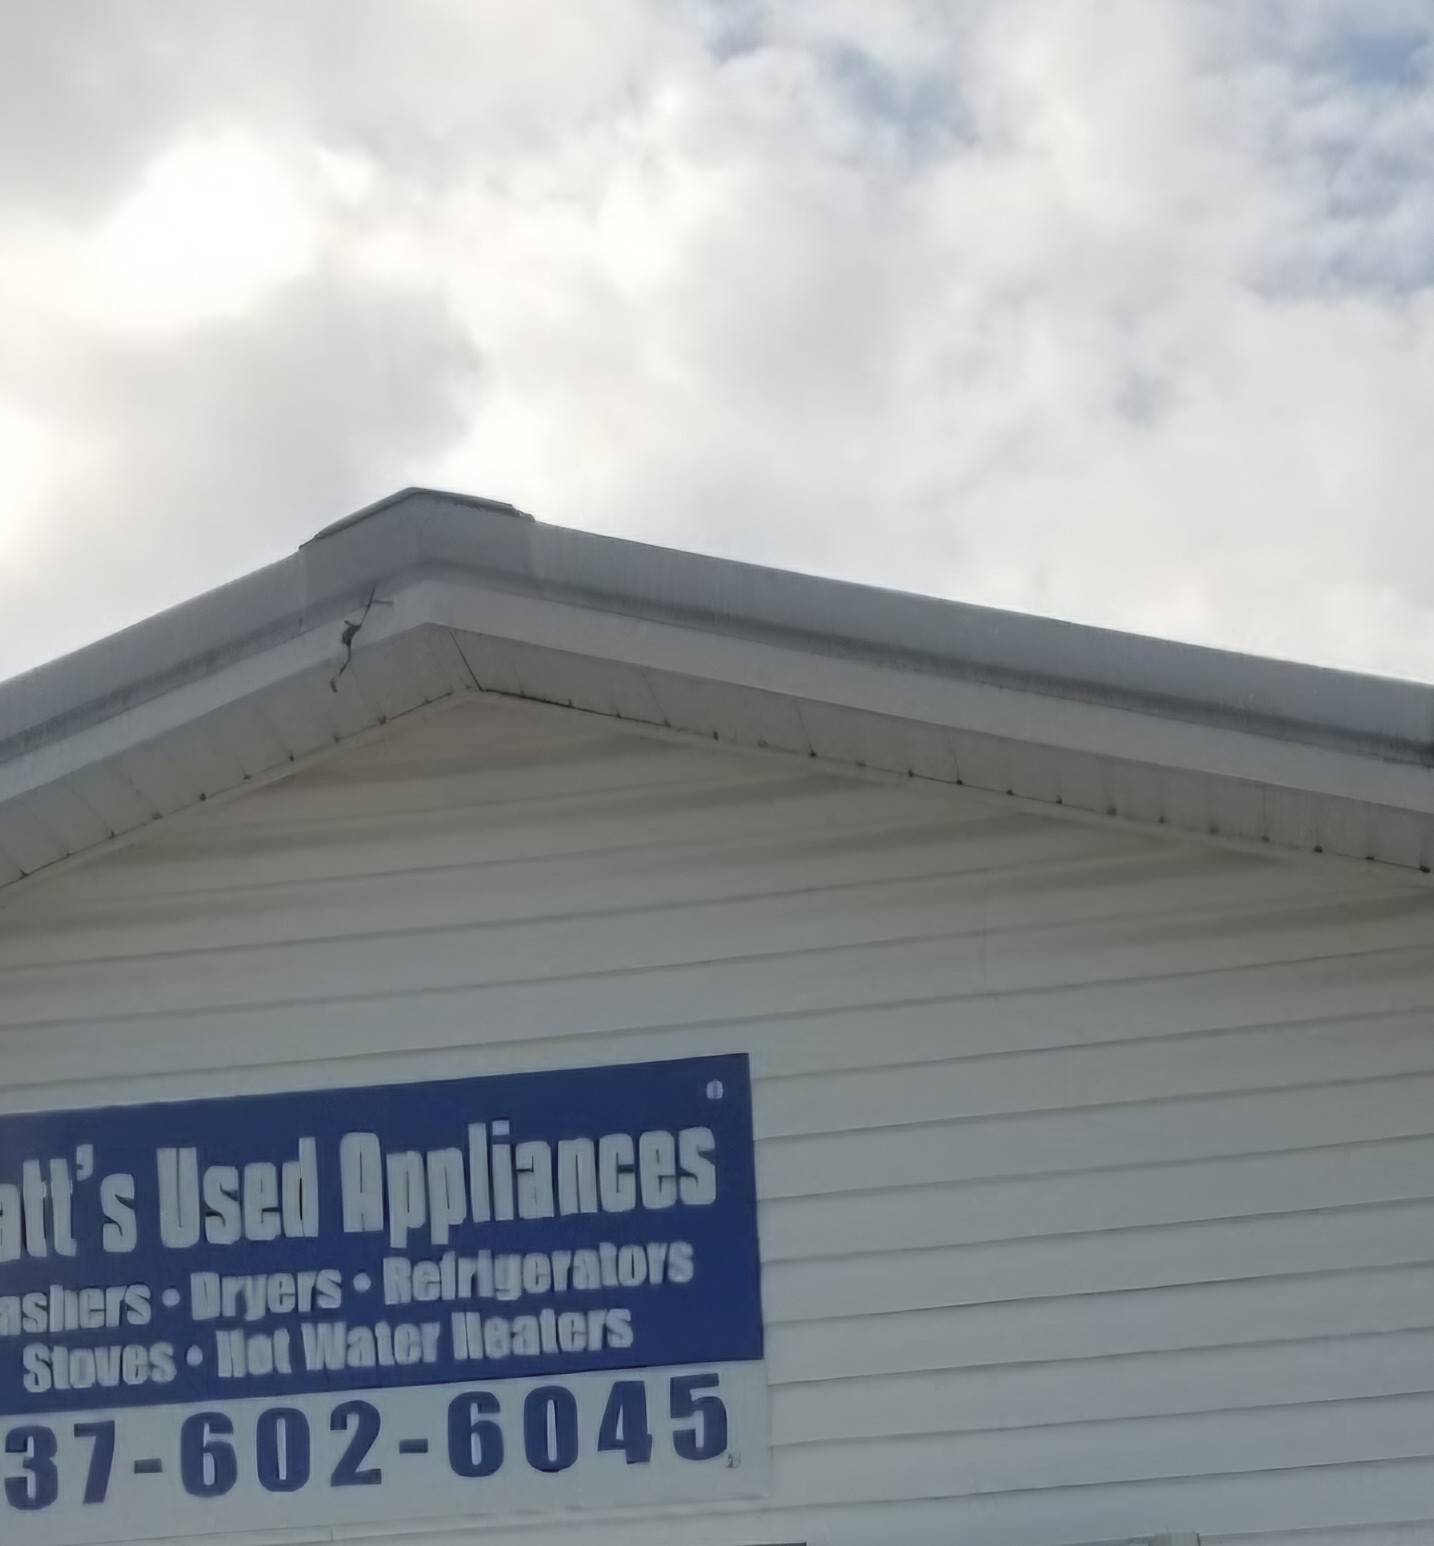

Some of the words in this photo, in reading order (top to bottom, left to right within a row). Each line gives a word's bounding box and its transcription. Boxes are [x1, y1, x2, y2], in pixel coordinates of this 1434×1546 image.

[156, 1136, 319, 1248] Used
[339, 1119, 717, 1249] Appliances
[190, 1268, 343, 1321] Dryers
[382, 1240, 695, 1306] Refrigerators
[22, 1341, 177, 1394] Stoves
[215, 1327, 292, 1378] Hot
[300, 1320, 441, 1371] Water
[451, 1308, 634, 1361] Heaters
